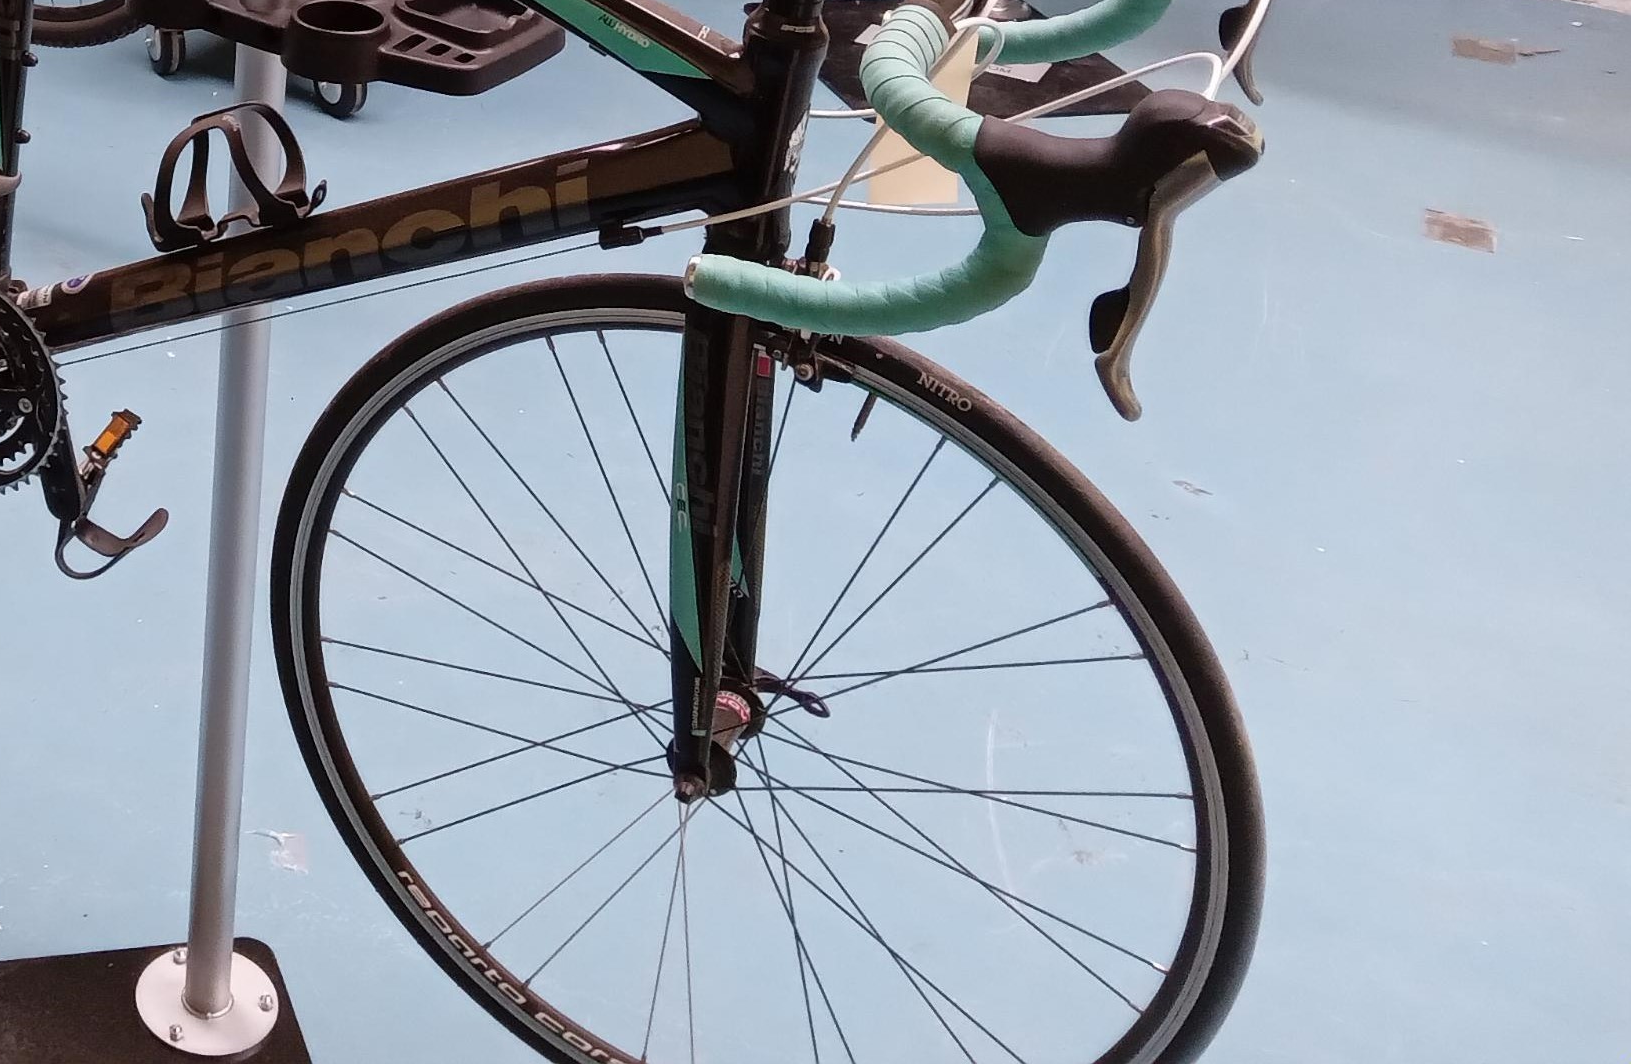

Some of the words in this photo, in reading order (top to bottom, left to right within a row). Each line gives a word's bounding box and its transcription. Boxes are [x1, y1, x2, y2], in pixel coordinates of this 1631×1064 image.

[109, 158, 590, 329] Bianchi
[916, 370, 973, 413] NITRO
[397, 869, 528, 1006] reparto
